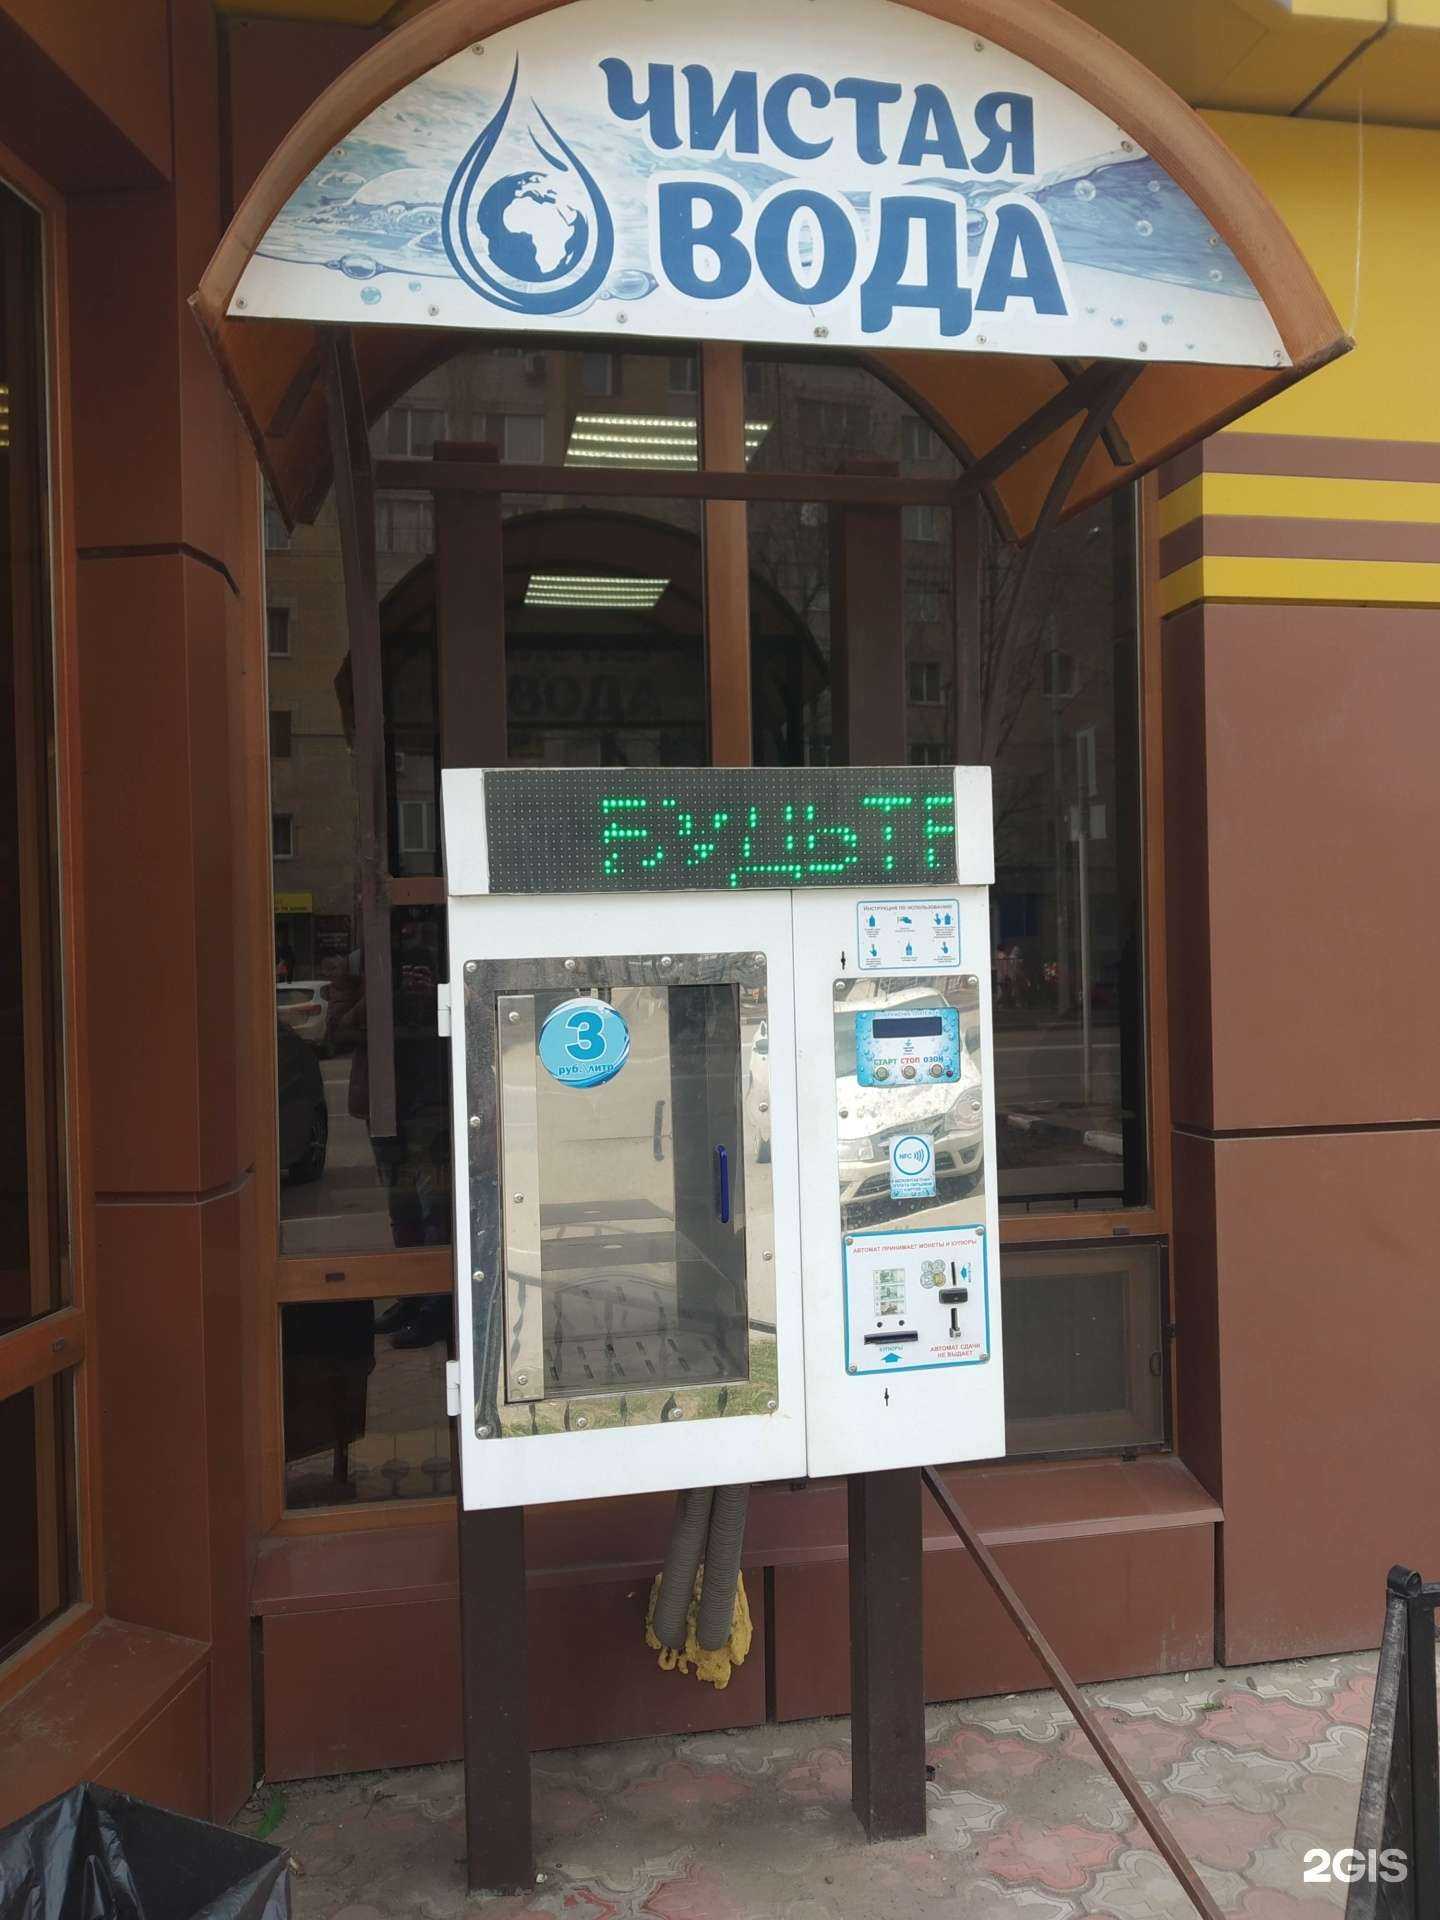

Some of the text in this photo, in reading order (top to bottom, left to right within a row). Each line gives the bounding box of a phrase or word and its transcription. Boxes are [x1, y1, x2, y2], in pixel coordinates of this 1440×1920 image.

[598, 56, 1036, 176] ЧИСТАЯ
[658, 180, 1068, 336] ВОДА
[565, 1009, 607, 1062] 3
[873, 1055, 944, 1066] СТАРТ СТОП ОЗОН
[853, 1245, 880, 1254] АВТОМАТ
[881, 1243, 917, 1252] ПРИНИМАЕТ
[918, 1241, 945, 1249] МОНЕТЫ
[951, 1239, 977, 1247] КУПЮРЫ
[930, 1344, 959, 1353] АВТОМАТ
